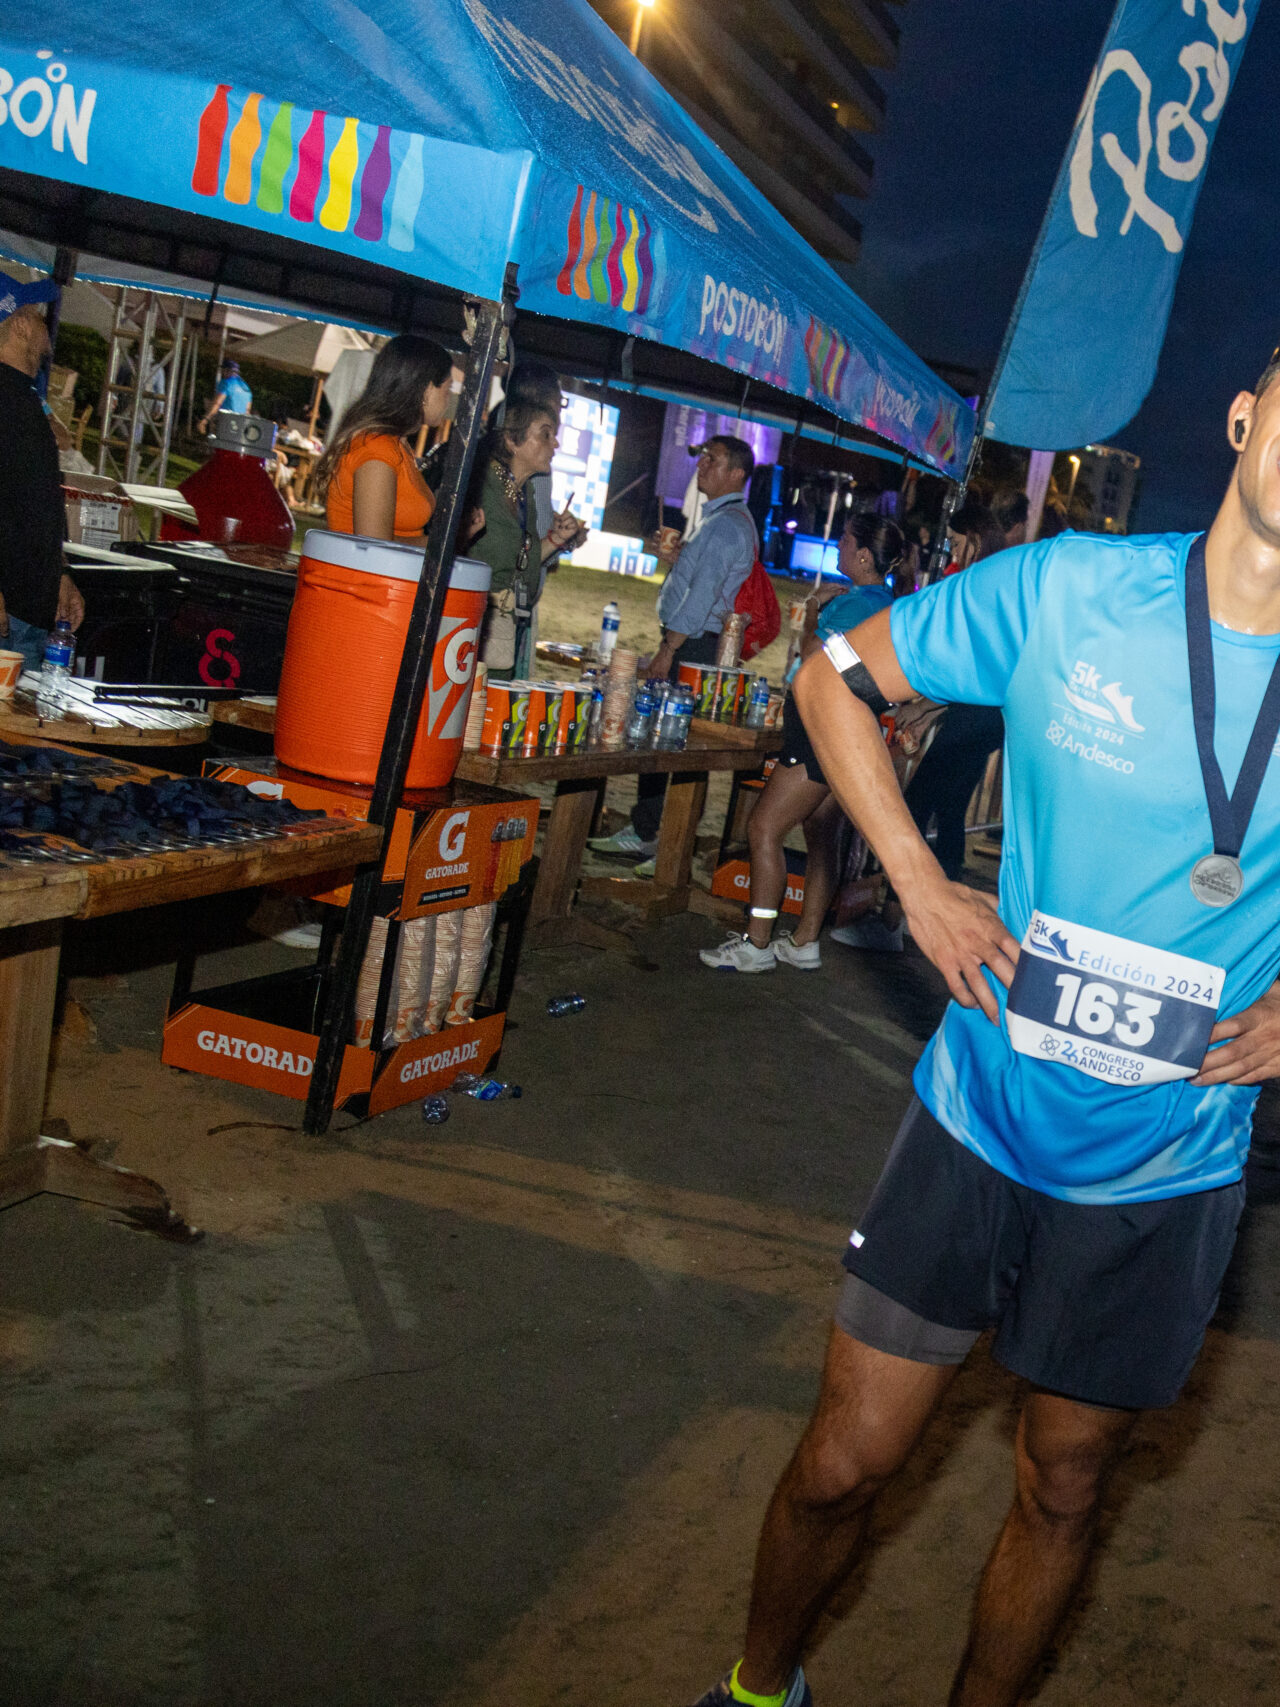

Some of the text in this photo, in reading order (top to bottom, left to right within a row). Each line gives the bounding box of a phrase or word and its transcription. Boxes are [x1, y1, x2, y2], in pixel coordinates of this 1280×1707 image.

[1061, 734, 1135, 775] Andesco
[1094, 727, 1125, 746] 2024
[439, 810, 471, 862] G
[425, 862, 470, 880] GATORADE
[1078, 950, 1214, 1003] Edición 2024
[1053, 973, 1162, 1047] 163
[197, 1029, 313, 1077] GATORAD
[400, 1039, 481, 1084] GATORADE
[1079, 1056, 1141, 1082] ANDESCO
[1082, 1046, 1144, 1072] CONGRESO
